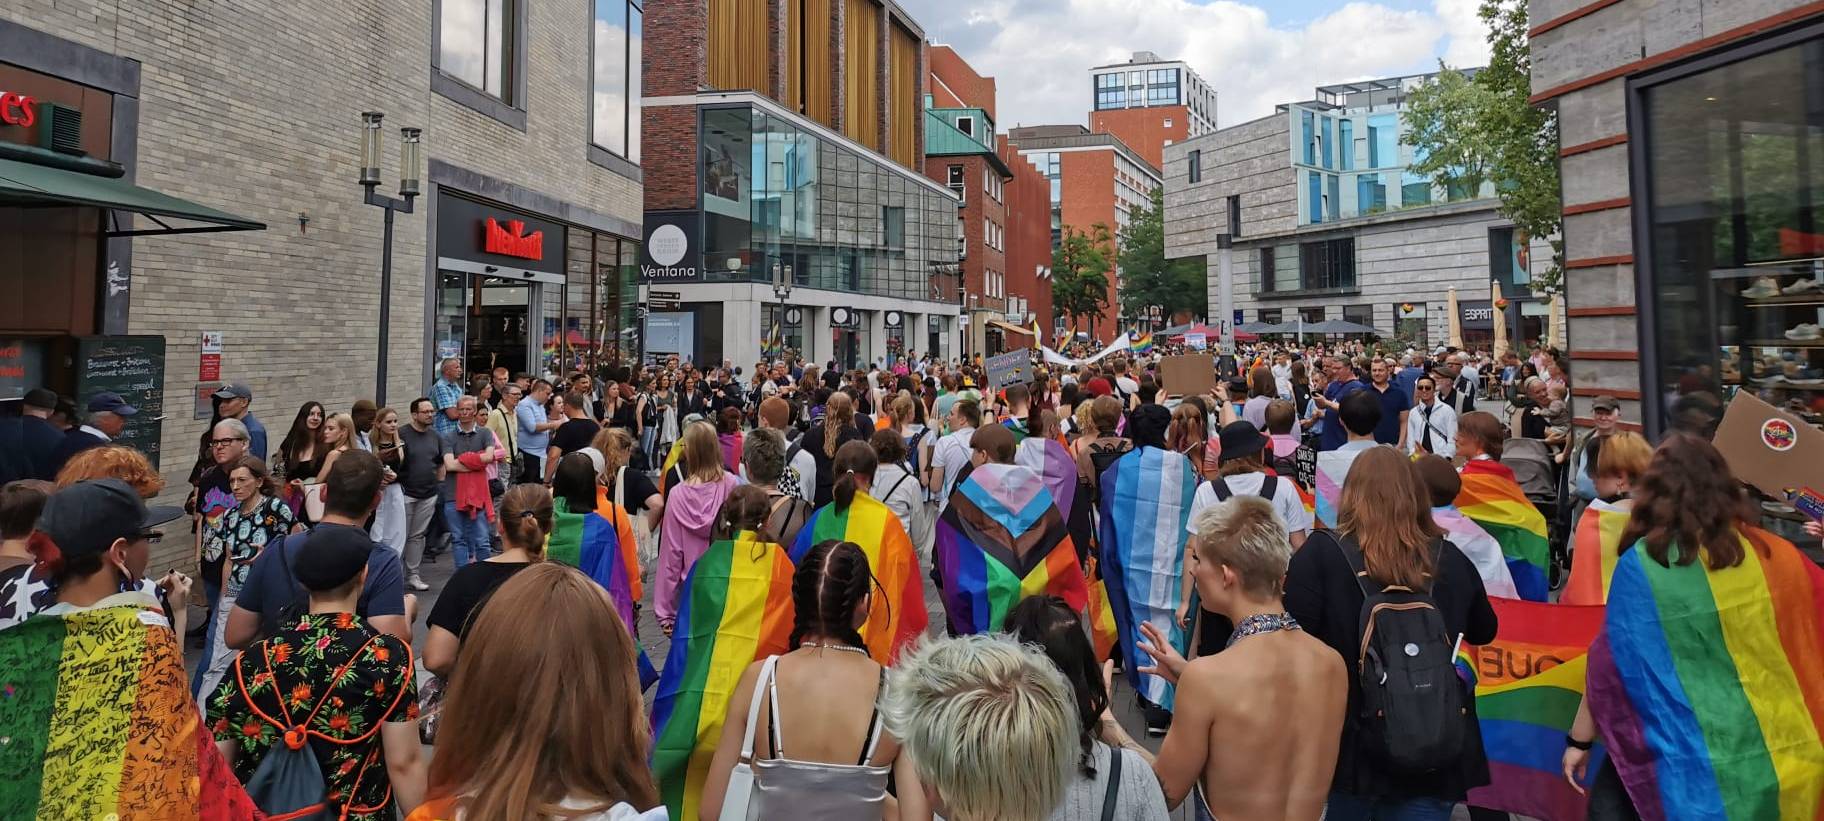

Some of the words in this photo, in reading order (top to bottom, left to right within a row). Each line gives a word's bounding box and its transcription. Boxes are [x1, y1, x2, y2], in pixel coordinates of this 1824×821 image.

[640, 264, 696, 277] Ventana
[1465, 308, 1492, 320] ESPRIT
[1297, 449, 1315, 463] SMASH
[1301, 461, 1311, 473] THE
